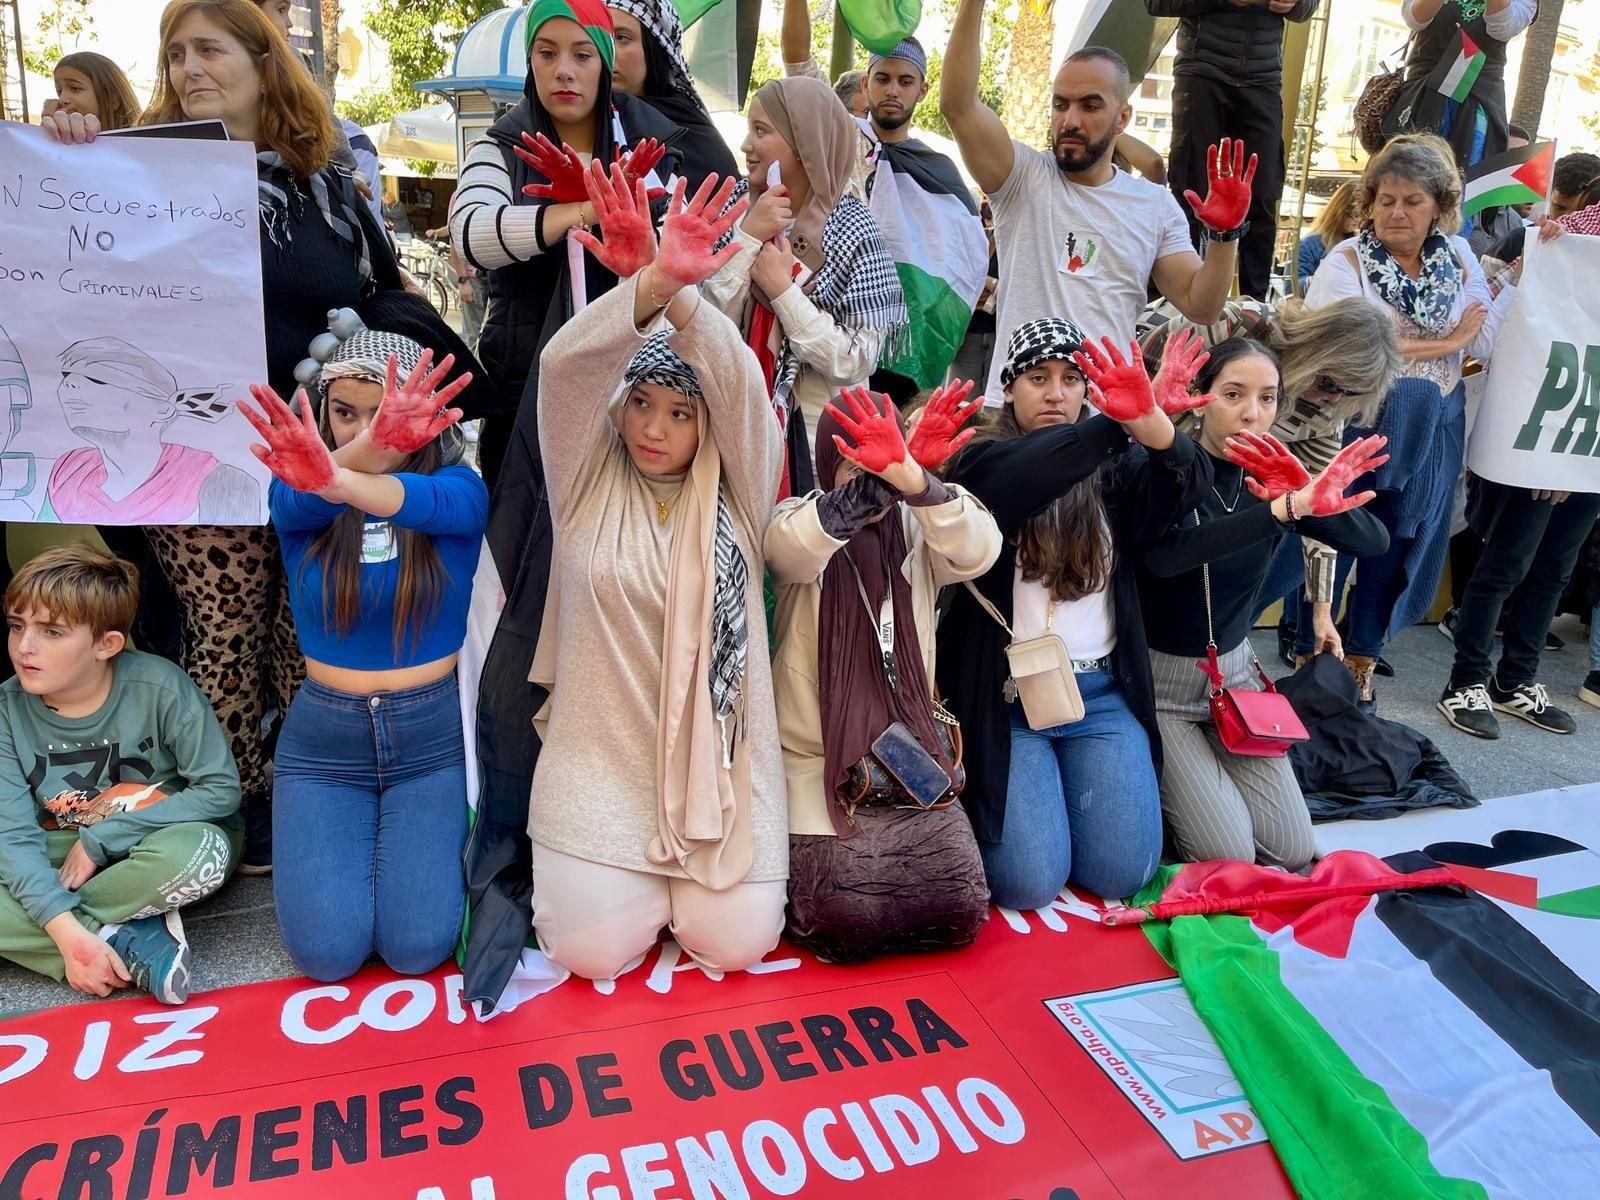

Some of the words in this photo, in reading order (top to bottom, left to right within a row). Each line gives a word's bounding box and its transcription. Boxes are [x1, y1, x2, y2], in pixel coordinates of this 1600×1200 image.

[38, 177, 246, 228] Secuestrados
[68, 221, 115, 262] NO
[1512, 340, 1600, 458] PA
[0, 1077, 484, 1200] CRÍMENES
[518, 1052, 633, 1130] DE
[659, 998, 969, 1102] GUERRA
[1056, 1002, 1168, 1121] www.apdha.org
[565, 1077, 1026, 1200] GENOCIDIO
[1193, 1108, 1257, 1151] AP
